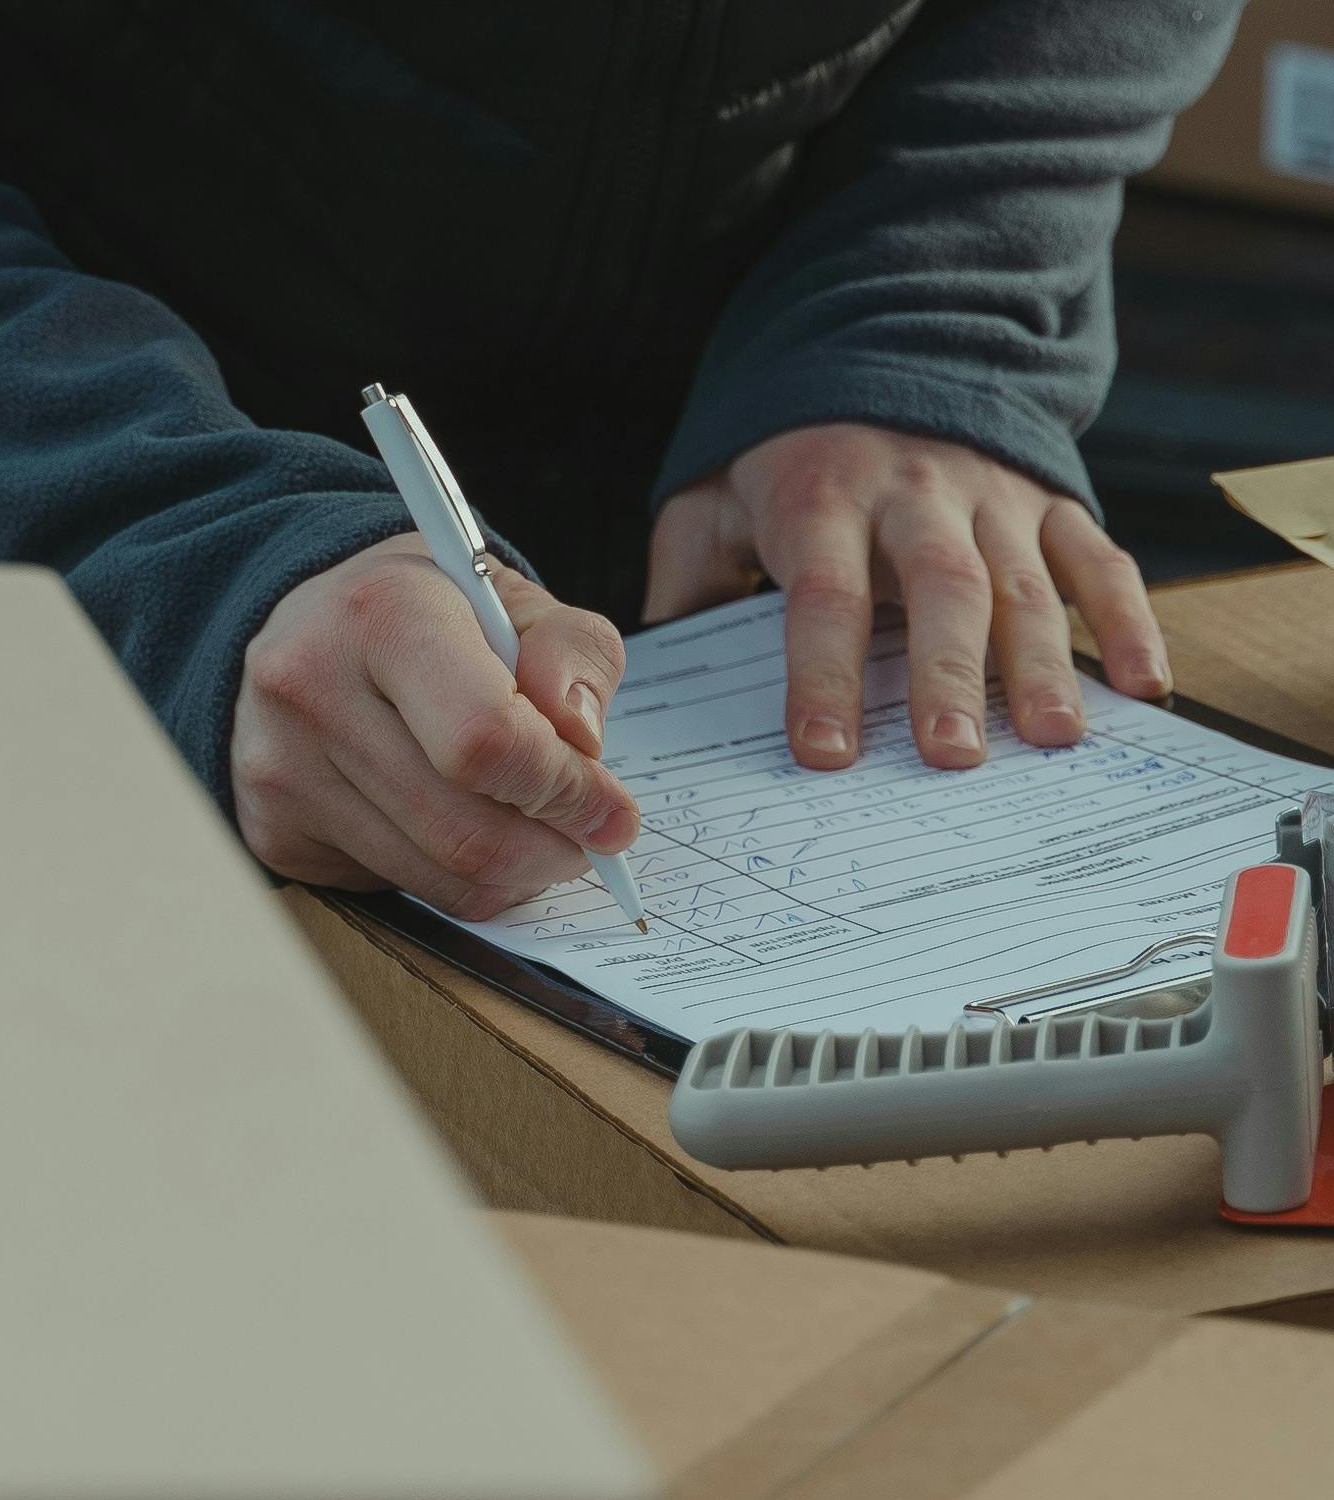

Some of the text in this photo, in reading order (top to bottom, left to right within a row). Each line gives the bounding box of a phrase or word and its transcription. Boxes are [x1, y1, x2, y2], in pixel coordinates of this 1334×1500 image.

[1137, 892, 1196, 907] Москва
[749, 925, 837, 948] предметов
[756, 928, 851, 954] Количество
[640, 958, 717, 973] ценность
[1150, 950, 1211, 965] ИСЬ
[634, 958, 745, 982] Объявленная
